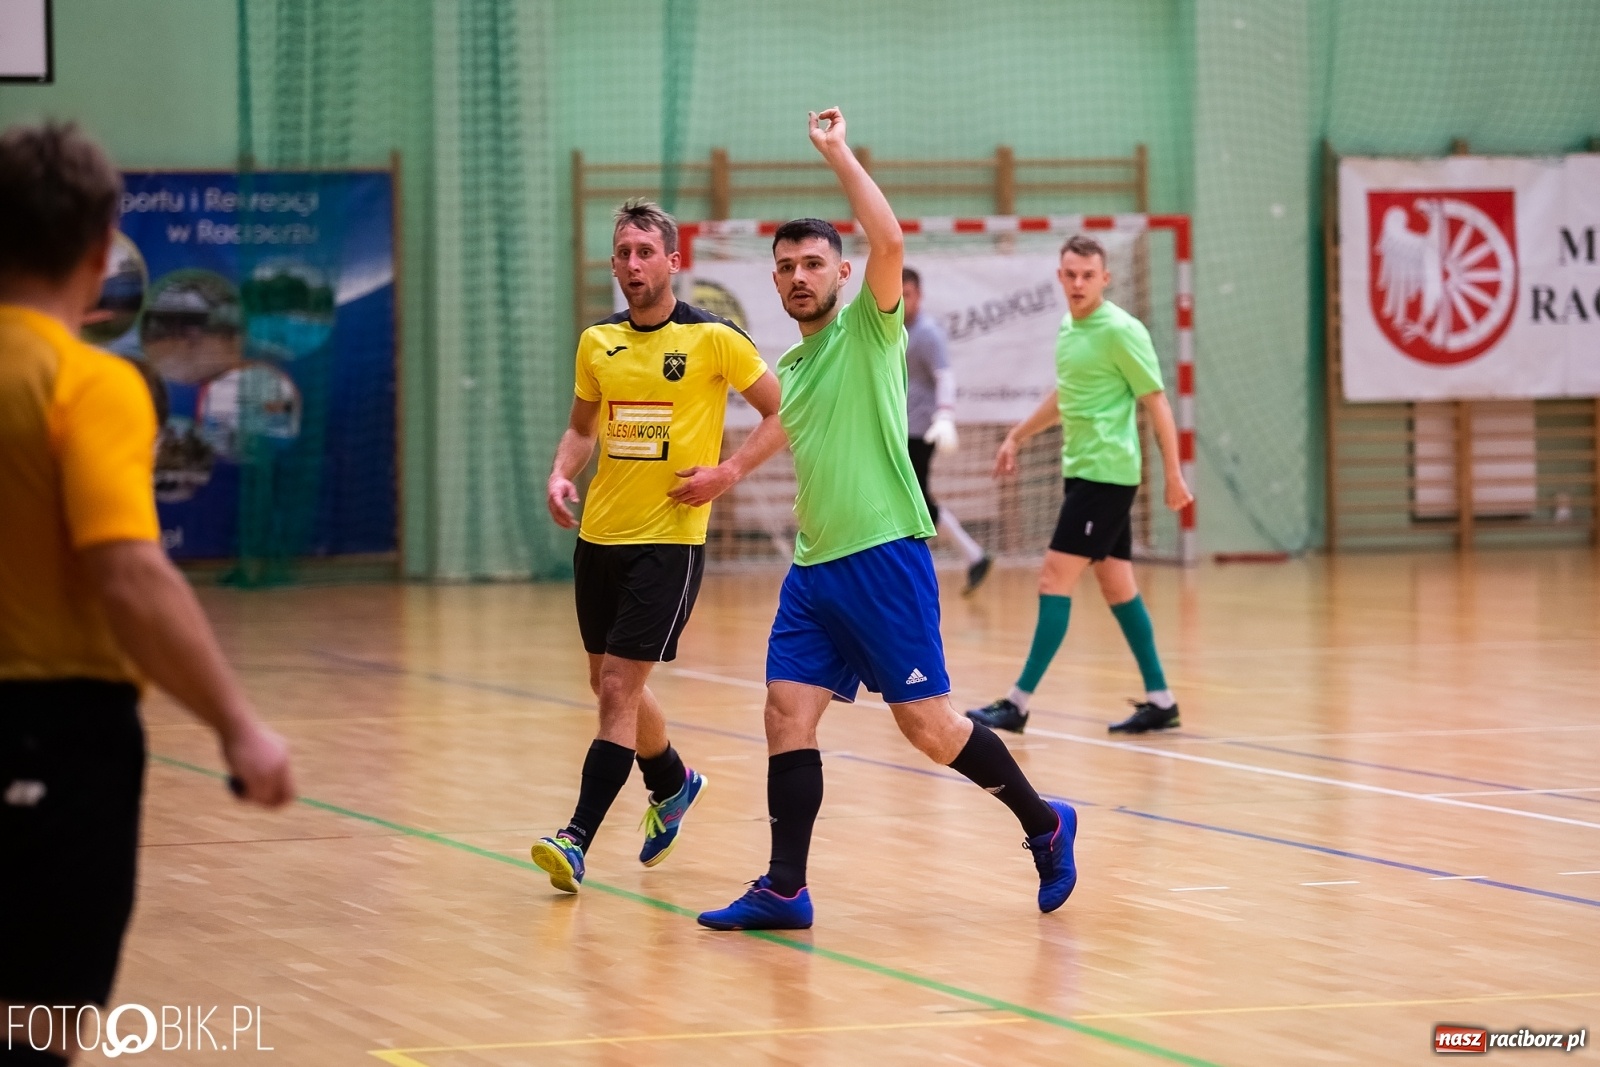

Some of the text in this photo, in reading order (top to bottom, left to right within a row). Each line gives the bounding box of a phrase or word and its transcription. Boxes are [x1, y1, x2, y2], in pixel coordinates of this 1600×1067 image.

[120, 188, 184, 213] portu
[204, 187, 319, 217] Rereacji
[1559, 226, 1600, 265] M
[1531, 284, 1600, 324] RA
[606, 422, 670, 439] SILESIAWORK
